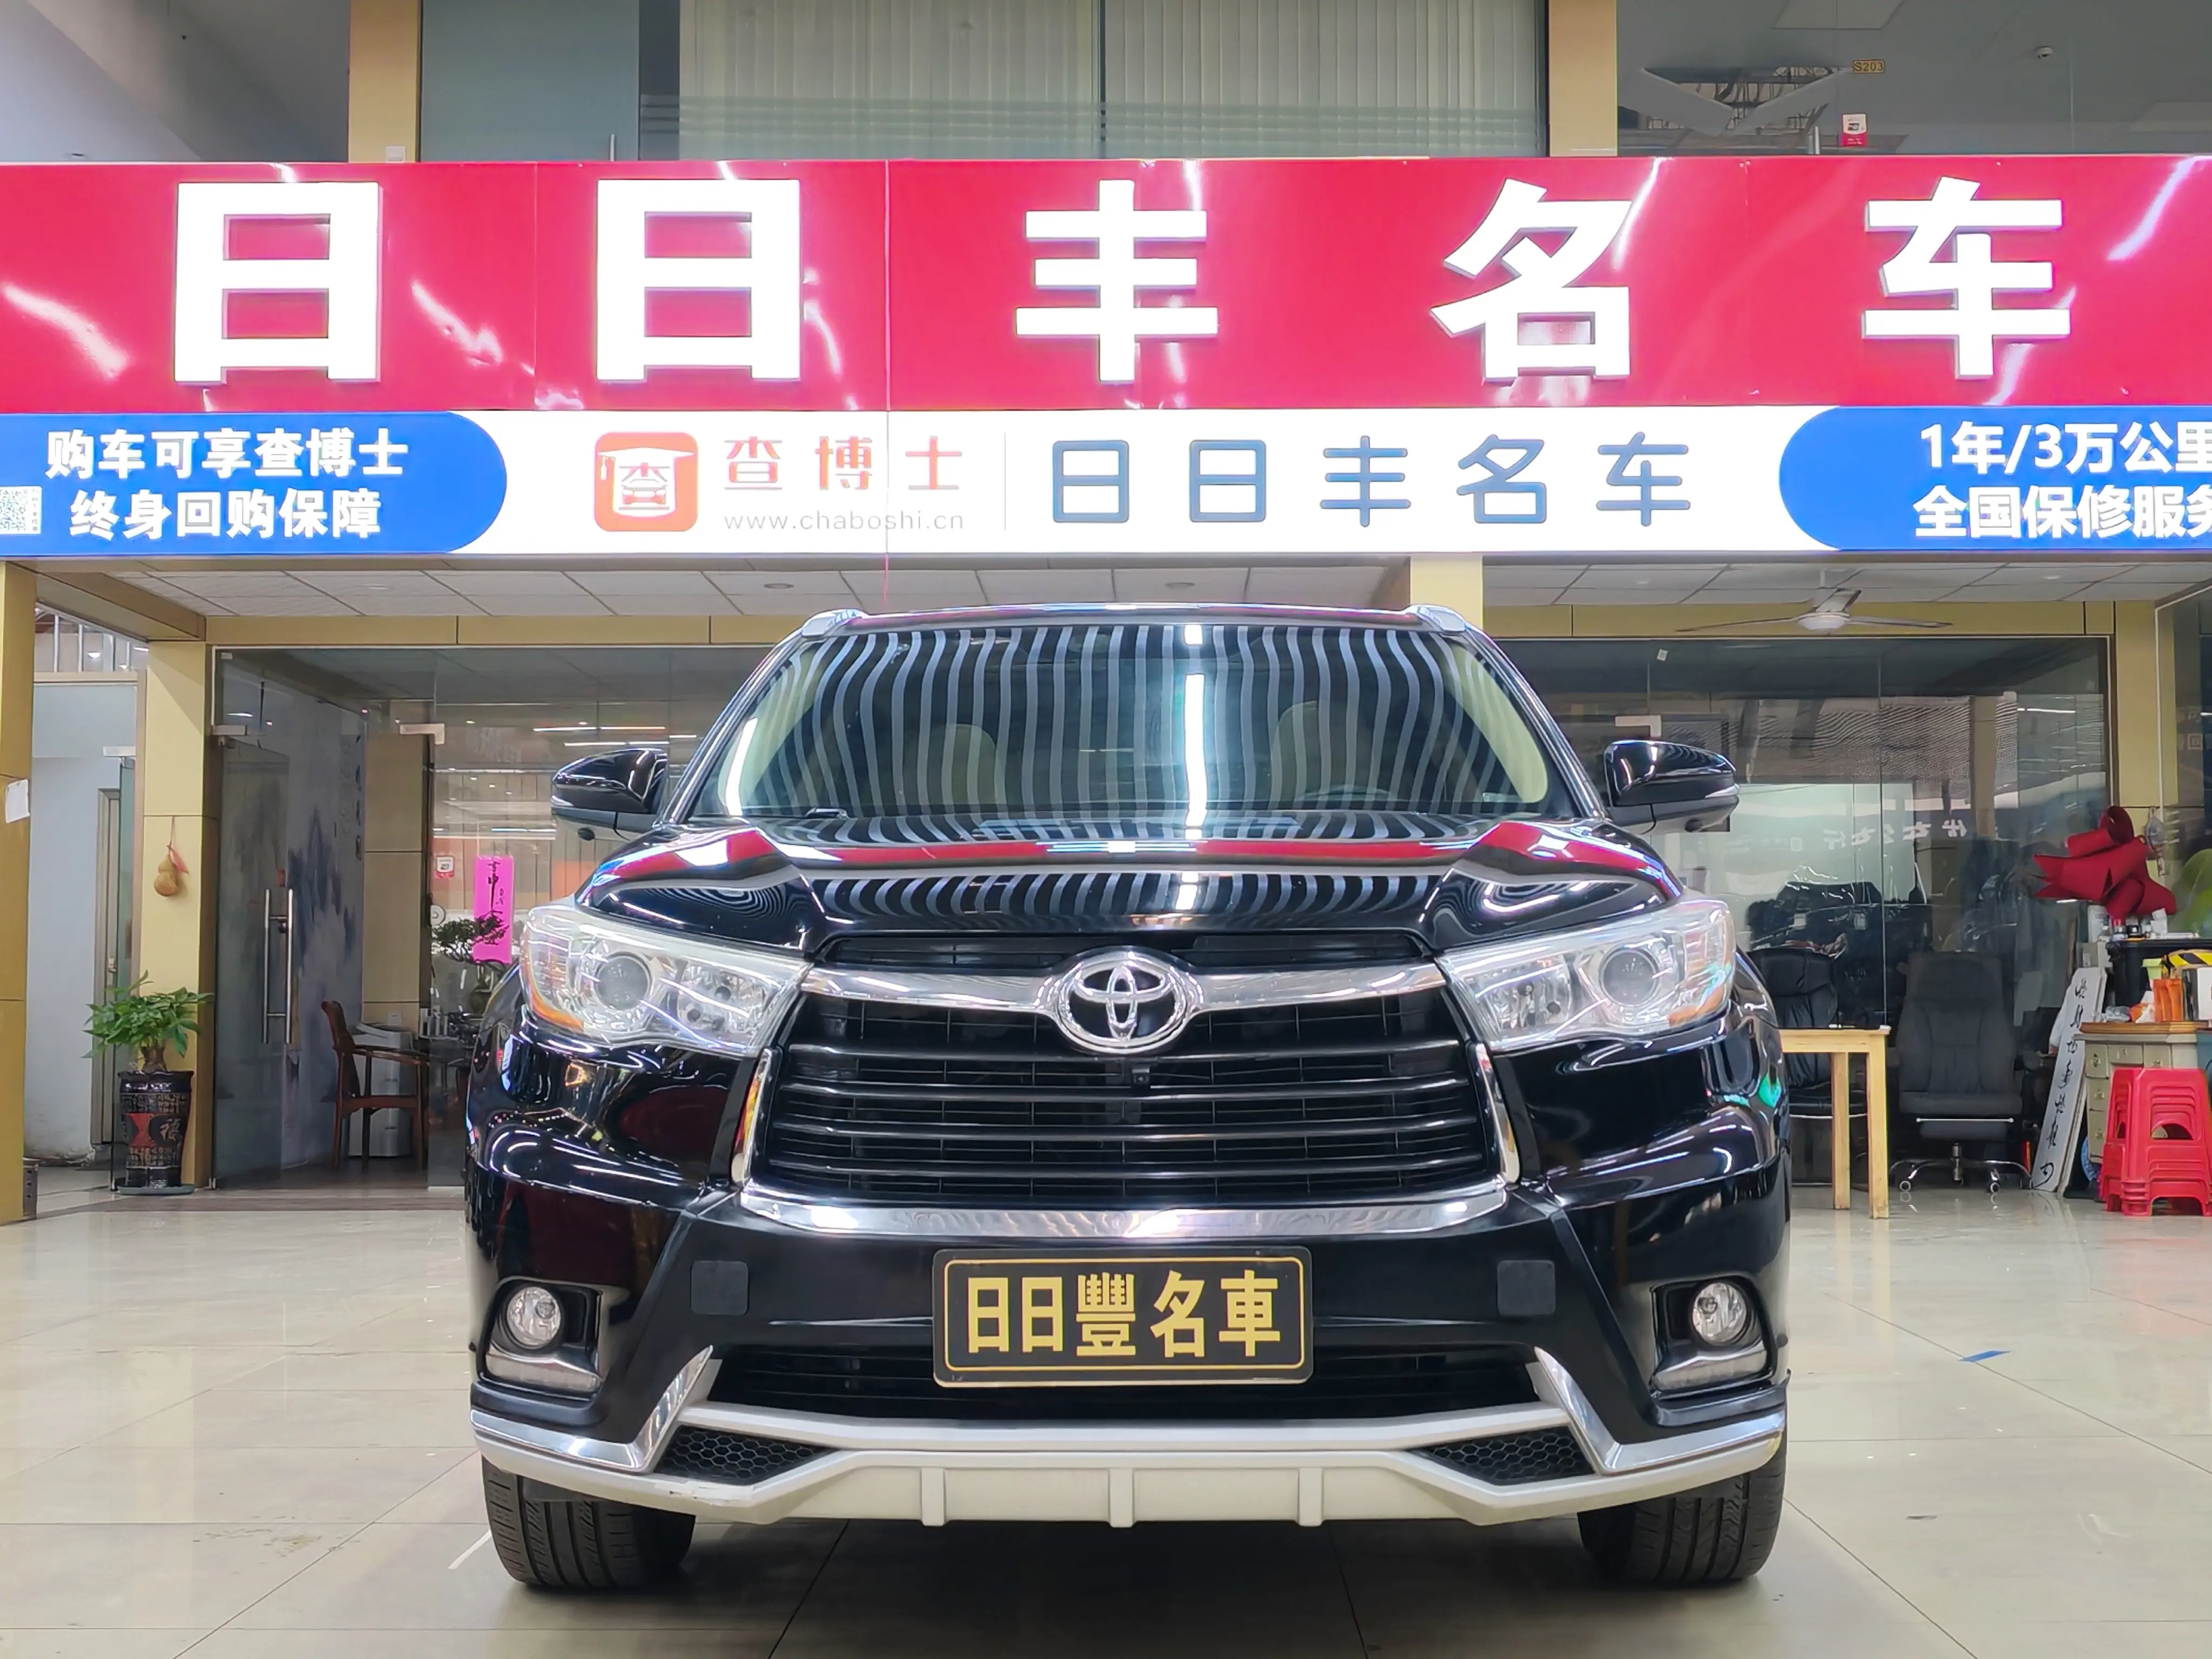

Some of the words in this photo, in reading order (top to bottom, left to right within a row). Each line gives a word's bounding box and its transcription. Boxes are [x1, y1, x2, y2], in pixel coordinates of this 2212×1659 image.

[1853, 62, 1883, 72] S203
[174, 176, 2071, 385] 日日丰名车
[45, 428, 408, 479] 购车可享查博士
[724, 435, 962, 491] 查博士
[1920, 421, 2212, 474] 1年/3万公里
[1052, 431, 1691, 528] 日日丰名车
[70, 488, 381, 540] 终身回购保障
[724, 510, 963, 530] www.chaboshi.cn
[968, 1270, 1280, 1358] 日日豐名車
